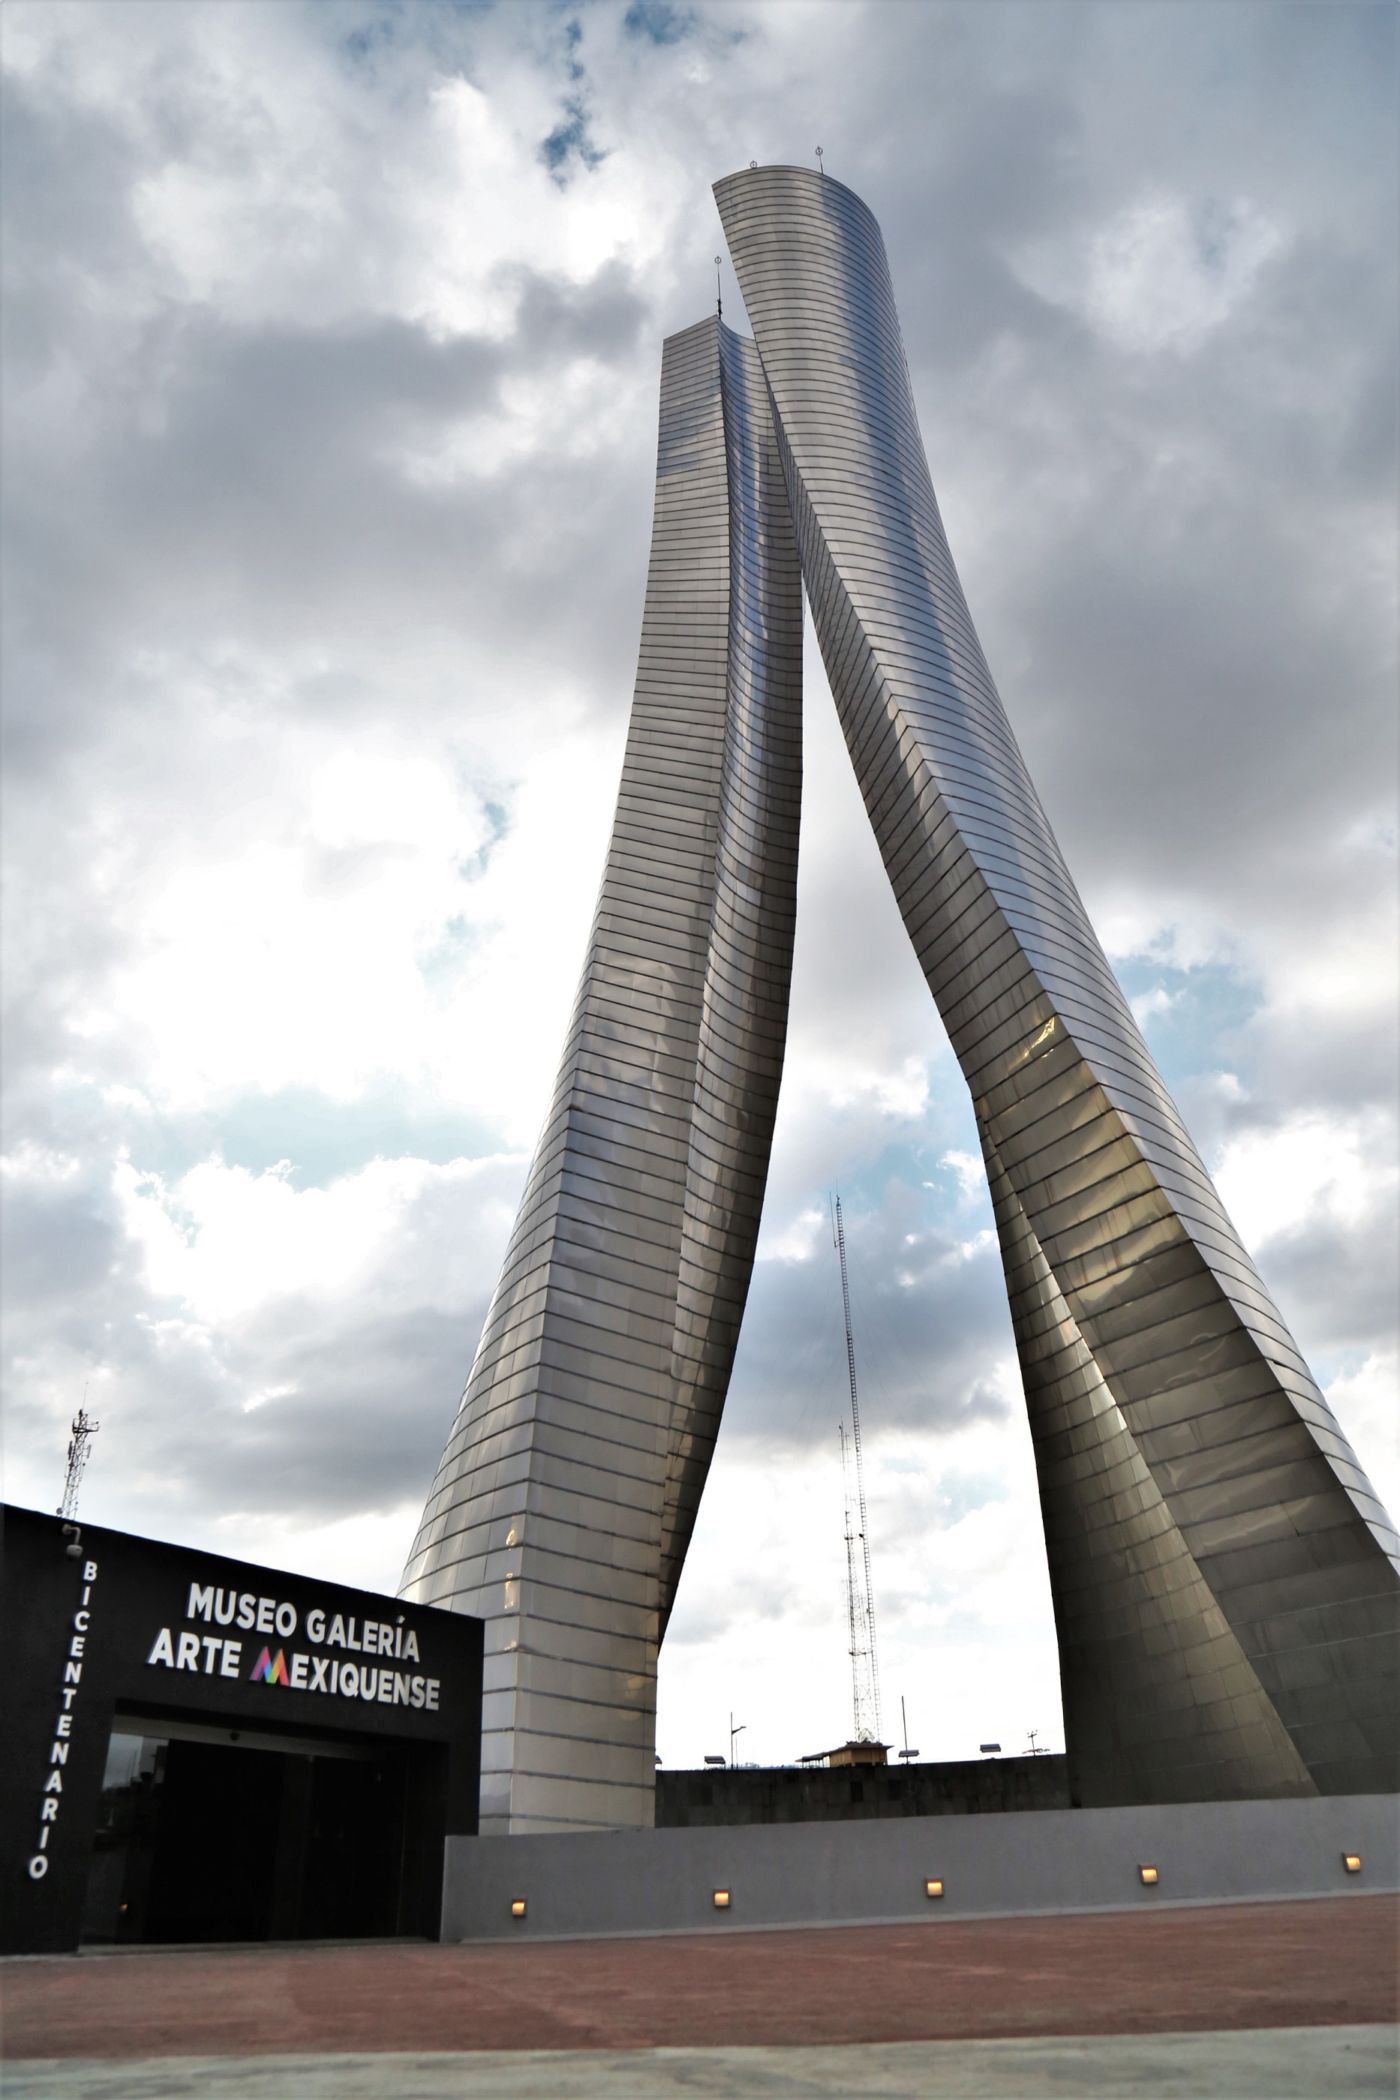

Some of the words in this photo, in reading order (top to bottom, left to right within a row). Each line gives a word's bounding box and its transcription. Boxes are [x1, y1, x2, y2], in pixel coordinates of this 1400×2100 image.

[186, 1583, 297, 1638] MUSEO
[306, 1609, 420, 1663] GALERÍA
[147, 1628, 242, 1678] ARTE
[249, 1646, 441, 1710] MEXIQUENSE
[29, 1561, 97, 1879] BICENTENARIO
